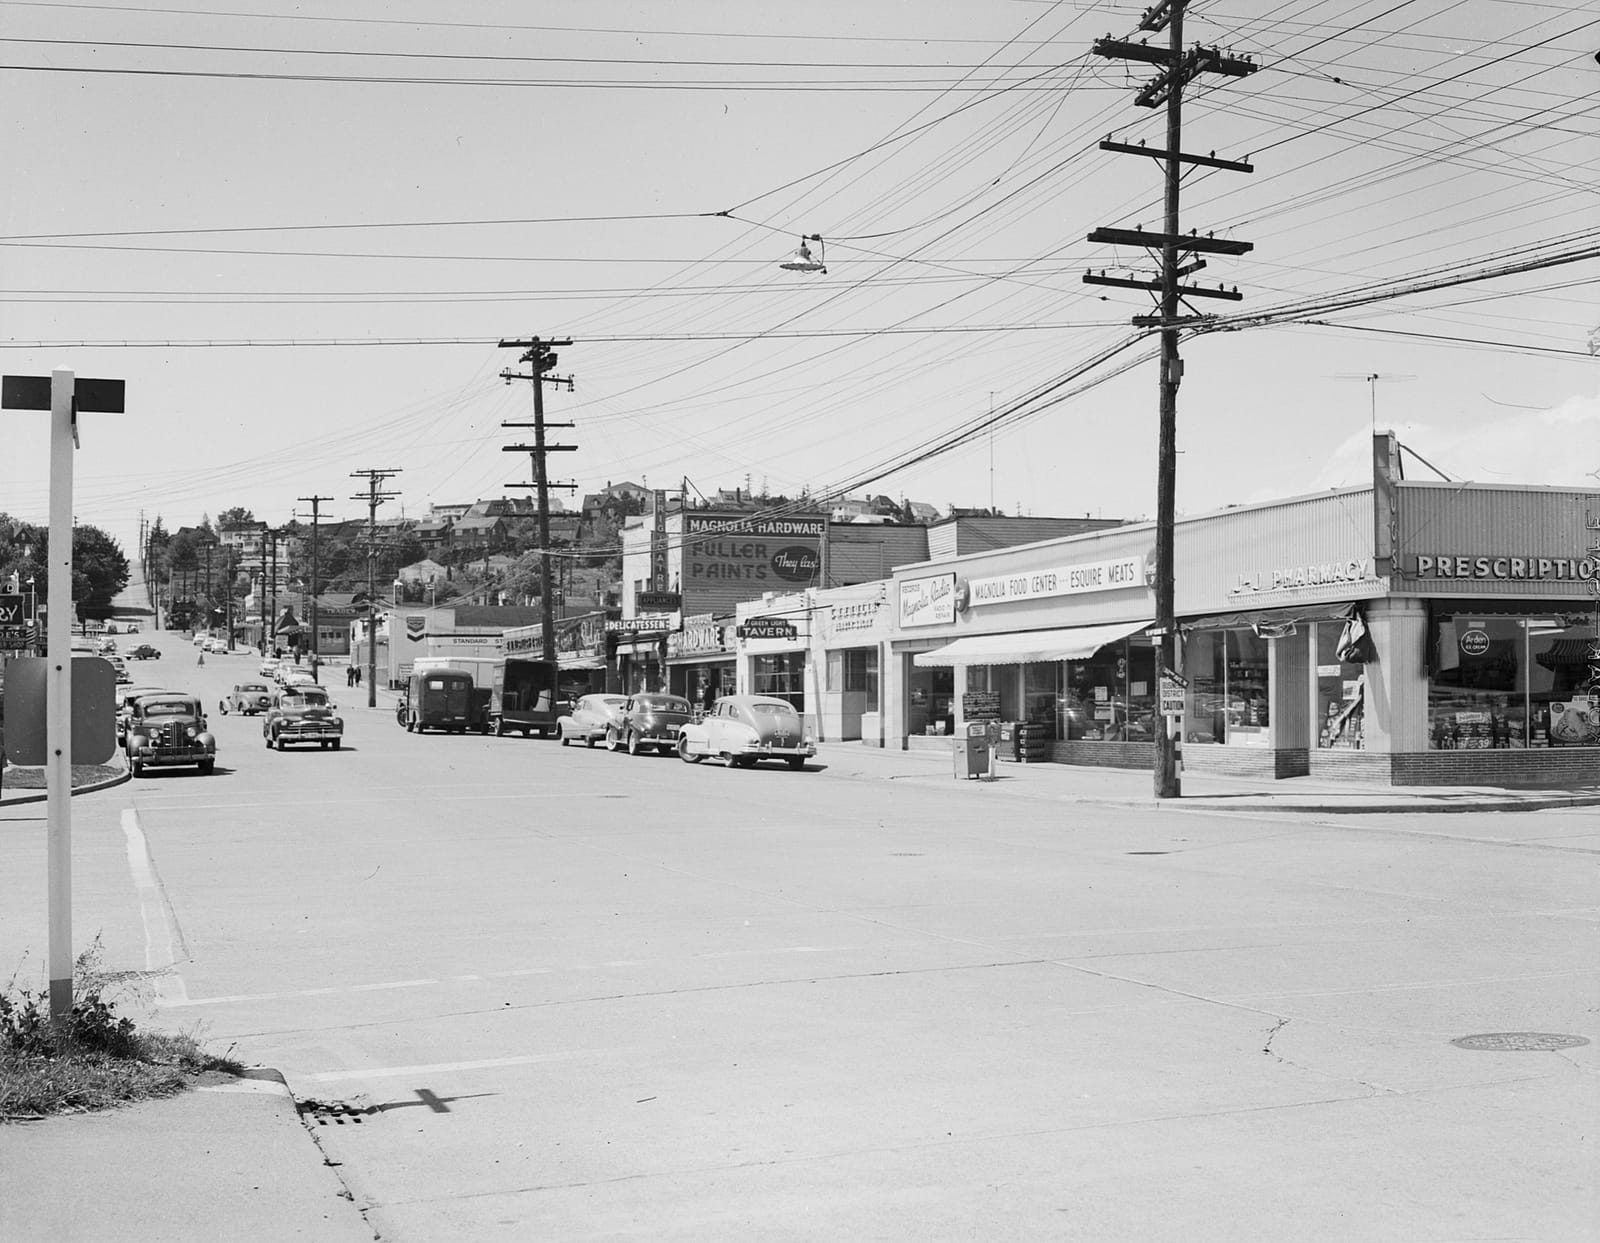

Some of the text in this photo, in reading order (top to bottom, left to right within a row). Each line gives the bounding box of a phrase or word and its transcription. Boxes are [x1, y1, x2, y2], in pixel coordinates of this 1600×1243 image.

[690, 519, 824, 534] MAGNOLIA HARDWARE
[692, 544, 767, 558] FULLER
[775, 551, 798, 573] They
[1417, 555, 1594, 580] PRESCRIPTIO
[692, 563, 767, 579] PAINTS
[1272, 558, 1369, 589] PHARMACY
[975, 562, 1134, 600] MAGNOLIA FOOD CENTER ESQUIRE MEATS
[902, 588, 929, 623] Magnolia
[930, 578, 951, 602] Radio
[608, 620, 665, 630] DELICATESSEN
[743, 627, 793, 636] TAVERN
[677, 626, 721, 649] HARDWARE
[1466, 634, 1487, 644] Arden
[1162, 690, 1184, 698] DISTRICT
[1163, 701, 1184, 710] CAUTION
